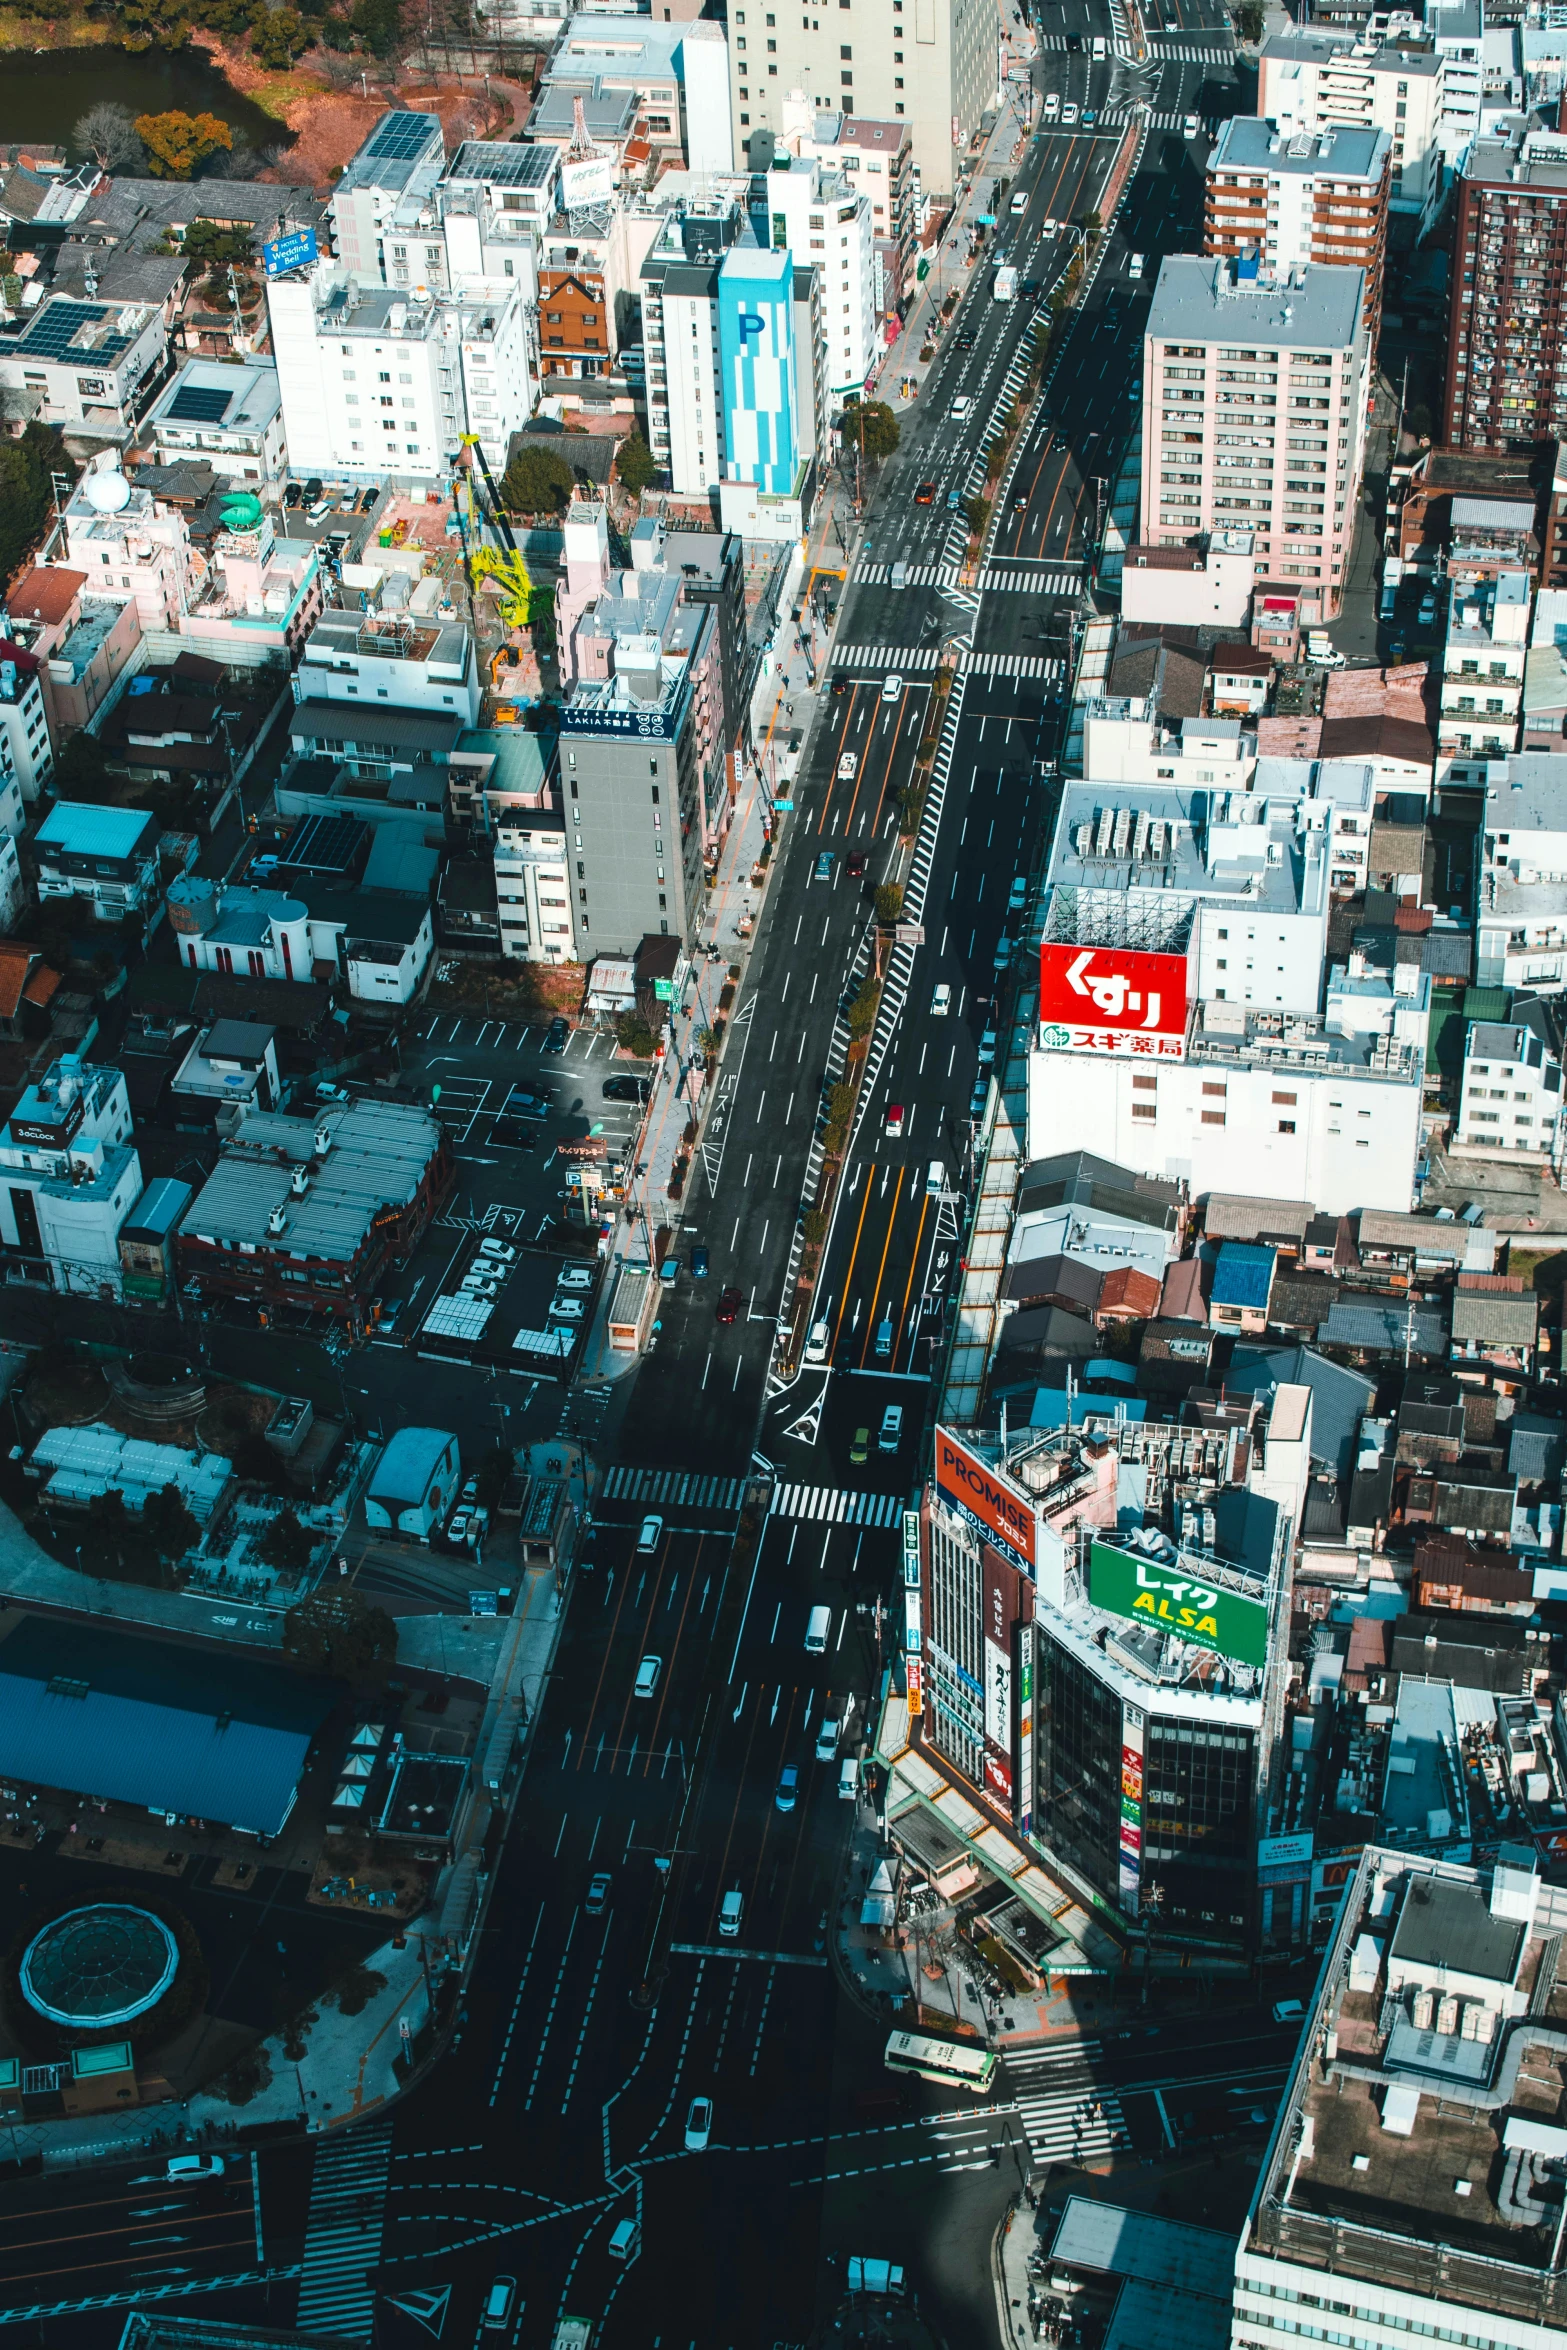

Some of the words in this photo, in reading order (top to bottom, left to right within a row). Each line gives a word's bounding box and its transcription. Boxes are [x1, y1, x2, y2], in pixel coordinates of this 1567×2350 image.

[571, 166, 605, 184] HOTEL
[272, 243, 309, 261] Wedding
[281, 239, 298, 249] HOTEL
[284, 253, 300, 266] Bell
[739, 314, 765, 344] P
[567, 717, 601, 726] LAKIA
[603, 719, 631, 728] 不動産
[1065, 951, 1161, 1028] くすり
[1073, 1031, 1182, 1056] スギ薬局
[711, 1074, 737, 1133] バス停
[568, 1174, 581, 1184] P
[943, 1446, 1028, 1538] PROMISE
[957, 1500, 1016, 1558] 隣のビル2F
[996, 1514, 1028, 1551] プロミス
[1136, 1564, 1218, 1610] レイク
[1132, 1591, 1218, 1638] ALSA
[1123, 1797, 1140, 1810] レイク
[1123, 1829, 1138, 1842] アコム
[946, 2046, 956, 2062] OSAKA
